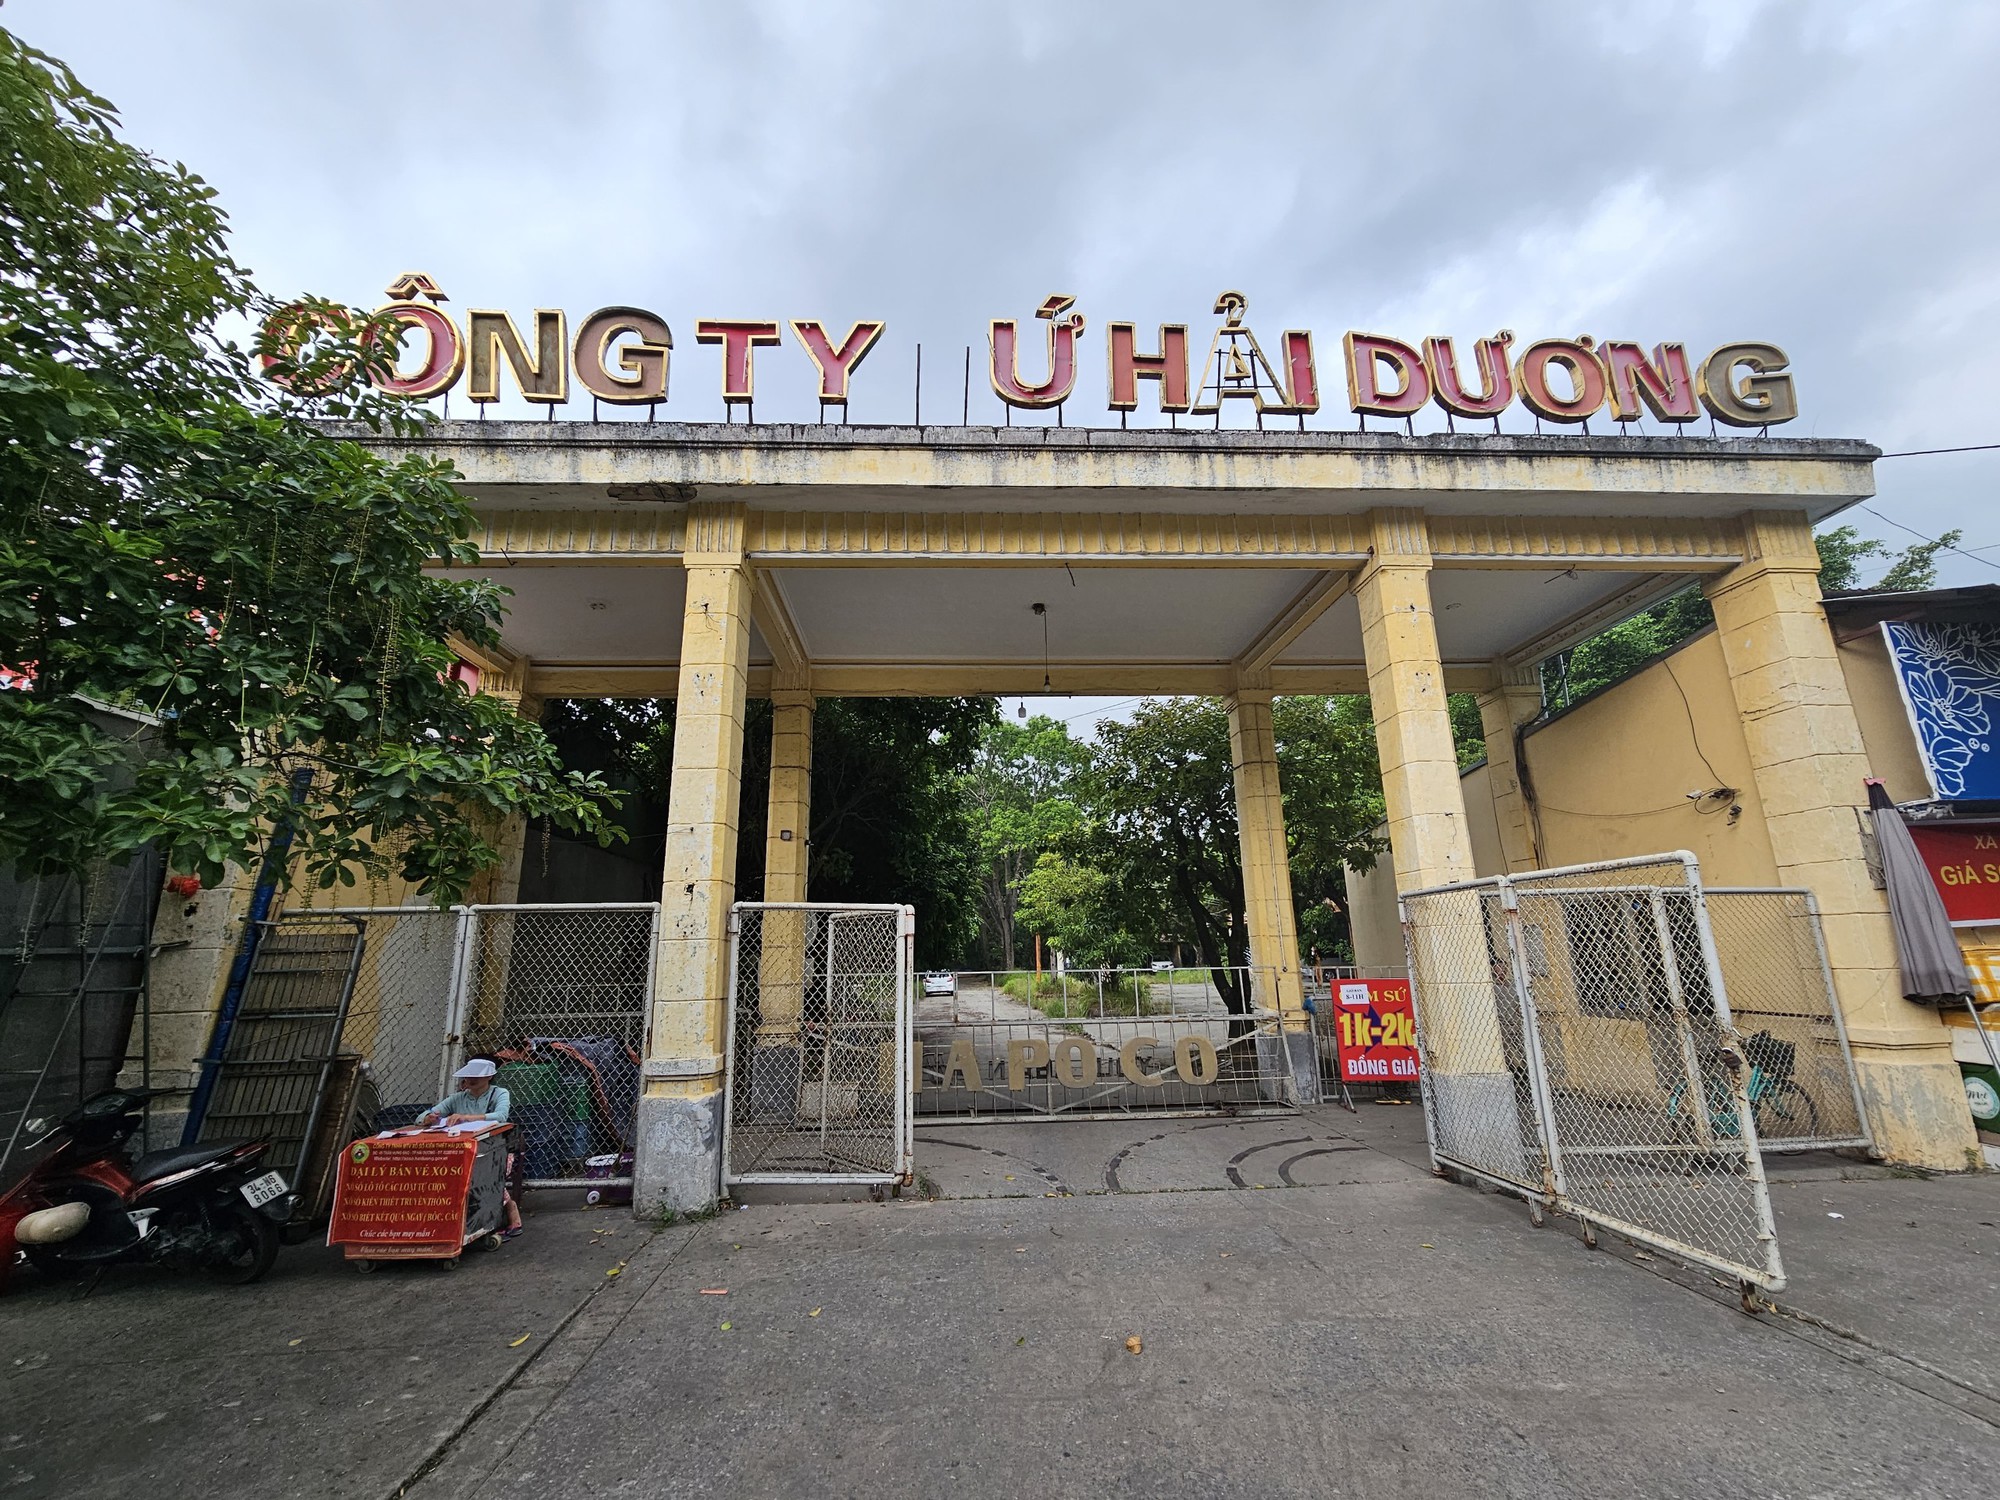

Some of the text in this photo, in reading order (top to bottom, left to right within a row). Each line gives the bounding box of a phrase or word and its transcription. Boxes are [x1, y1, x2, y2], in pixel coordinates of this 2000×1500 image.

[695, 319, 887, 404] TY
[1342, 328, 1800, 427] DƯƠNG
[1983, 863, 2000, 883] S
[1383, 987, 1406, 1002] SỨ
[1339, 1012, 1415, 1047] 1k-2k
[1348, 1054, 1417, 1075] ĐỒNG GIÁ
[253, 1183, 283, 1204] 8066
